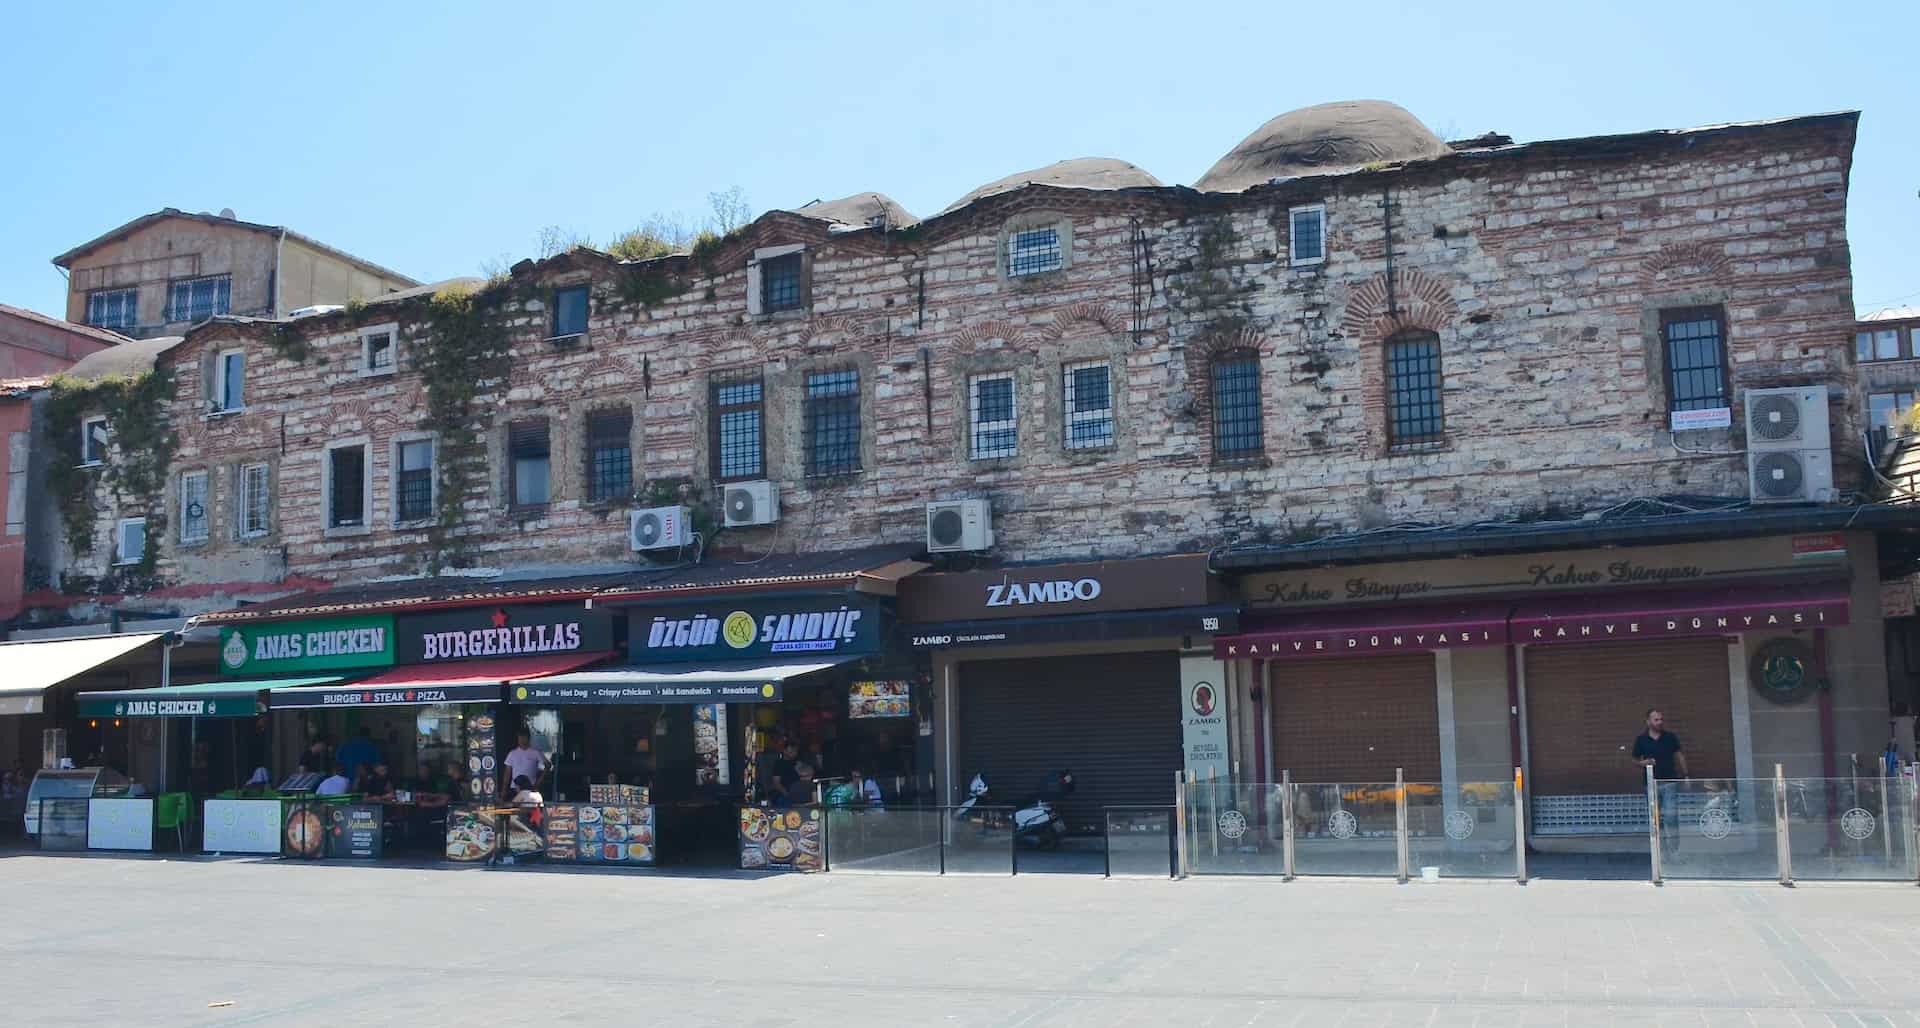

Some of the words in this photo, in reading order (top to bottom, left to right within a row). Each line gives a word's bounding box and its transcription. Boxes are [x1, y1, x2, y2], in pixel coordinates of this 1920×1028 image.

[1528, 564, 1601, 585] Kahve
[1608, 561, 1702, 582] Dünyası
[986, 578, 1102, 607] ZAMBO
[1263, 583, 1332, 603] Kahve
[1345, 578, 1432, 600] Dünyası
[648, 613, 720, 648] ÖZGÜR
[760, 606, 862, 643] SANDVİÇ
[1202, 617, 1219, 631] 1950
[1533, 622, 1640, 638] KAHVE
[1667, 611, 1825, 630] DÜNYASI
[255, 637, 302, 660] ANAS
[306, 628, 385, 657] CHICKEN
[423, 622, 580, 659] BURGERILLAS
[912, 635, 951, 646] ZAMBO
[1228, 640, 1325, 655] KAHVE
[1348, 630, 1490, 648] DÜNYASI
[323, 694, 362, 704] BURGER
[374, 692, 404, 702] STEAK
[417, 690, 446, 701] PIZZA
[560, 689, 573, 698] Hot
[574, 689, 588, 699] Dog
[598, 688, 620, 699] Crispy
[622, 687, 651, 696] Chicken
[676, 686, 711, 696] Sandwich
[127, 701, 156, 715] ANAS
[158, 700, 204, 715] CHICKEN
